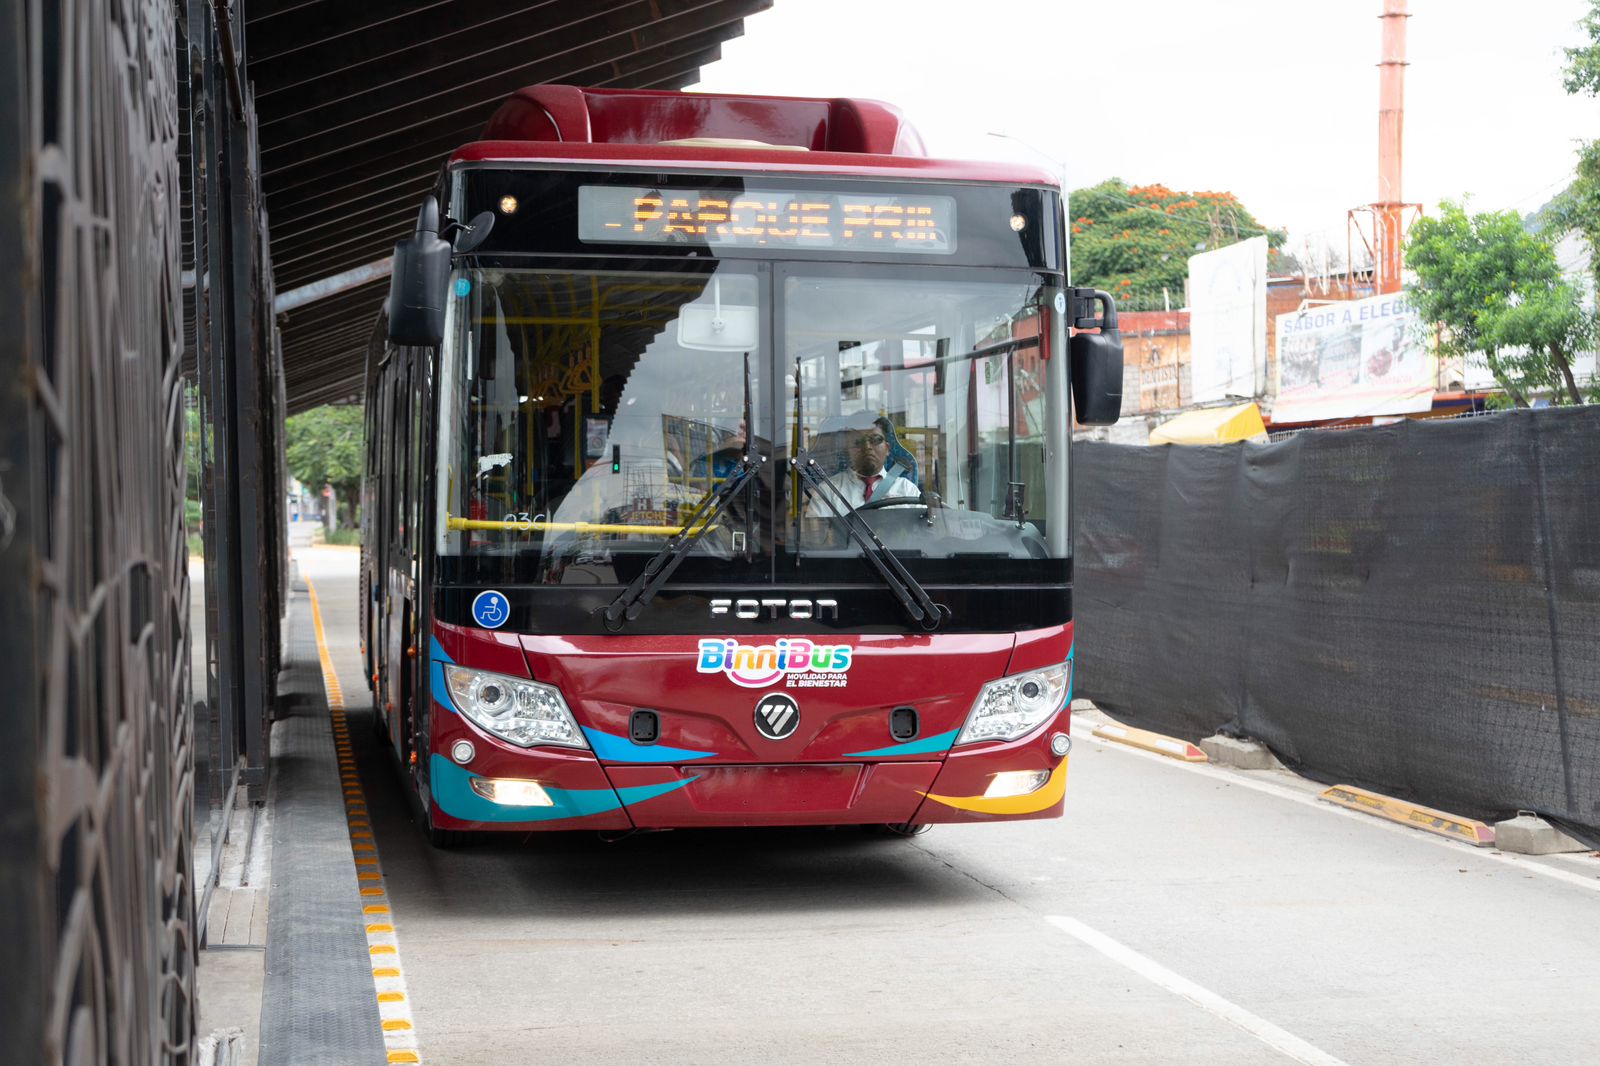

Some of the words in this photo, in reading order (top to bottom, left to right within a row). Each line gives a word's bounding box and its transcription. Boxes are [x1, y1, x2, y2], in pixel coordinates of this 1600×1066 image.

[634, 198, 830, 241] PARQUE
[1284, 312, 1336, 334] SABOR
[1342, 309, 1353, 323] A
[709, 599, 838, 619] FOTON
[699, 640, 850, 671] BinniBus
[798, 680, 848, 688] BIENESTAR
